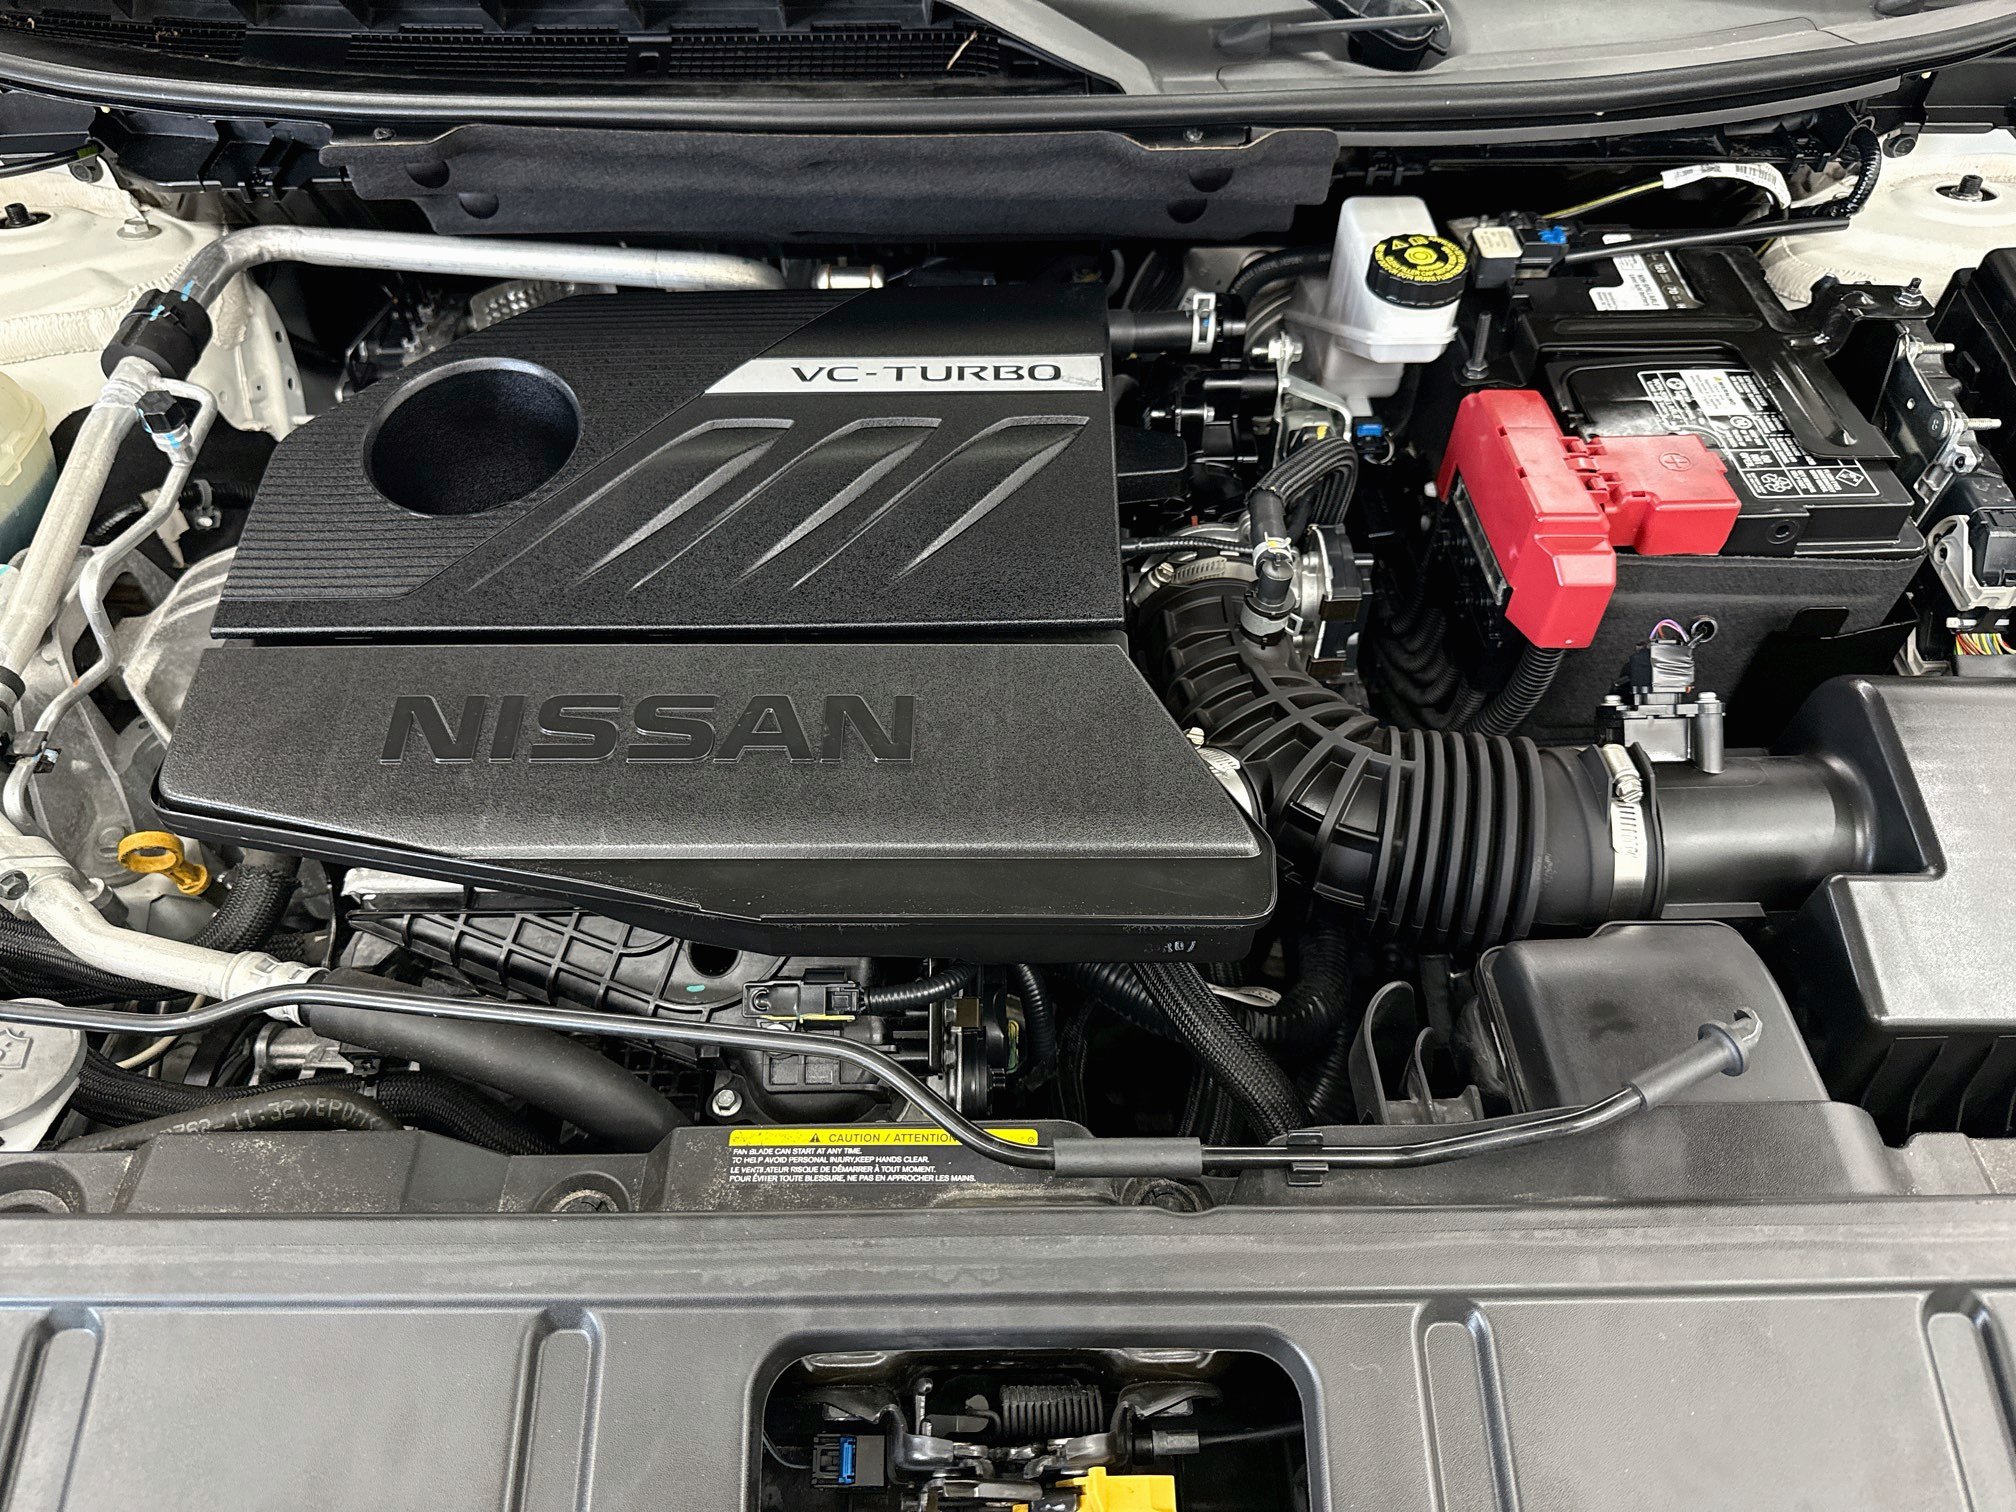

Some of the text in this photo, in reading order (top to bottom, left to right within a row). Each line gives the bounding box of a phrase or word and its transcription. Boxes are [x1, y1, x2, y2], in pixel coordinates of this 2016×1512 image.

[791, 364, 1062, 382] VC-TURBO
[379, 694, 915, 765] NISSAN
[828, 1133, 880, 1143] CAUTION
[844, 1147, 863, 1155] TIME.
[876, 1156, 902, 1164] HANDS
[903, 1156, 930, 1164] CLEAR.
[790, 1166, 819, 1174] RISQUE
[820, 1166, 831, 1174] DE
[832, 1164, 873, 1173] DÉMARRER
[874, 1164, 880, 1173] À
[730, 1175, 752, 1183] POUR
[752, 1174, 780, 1183] ÉVITER
